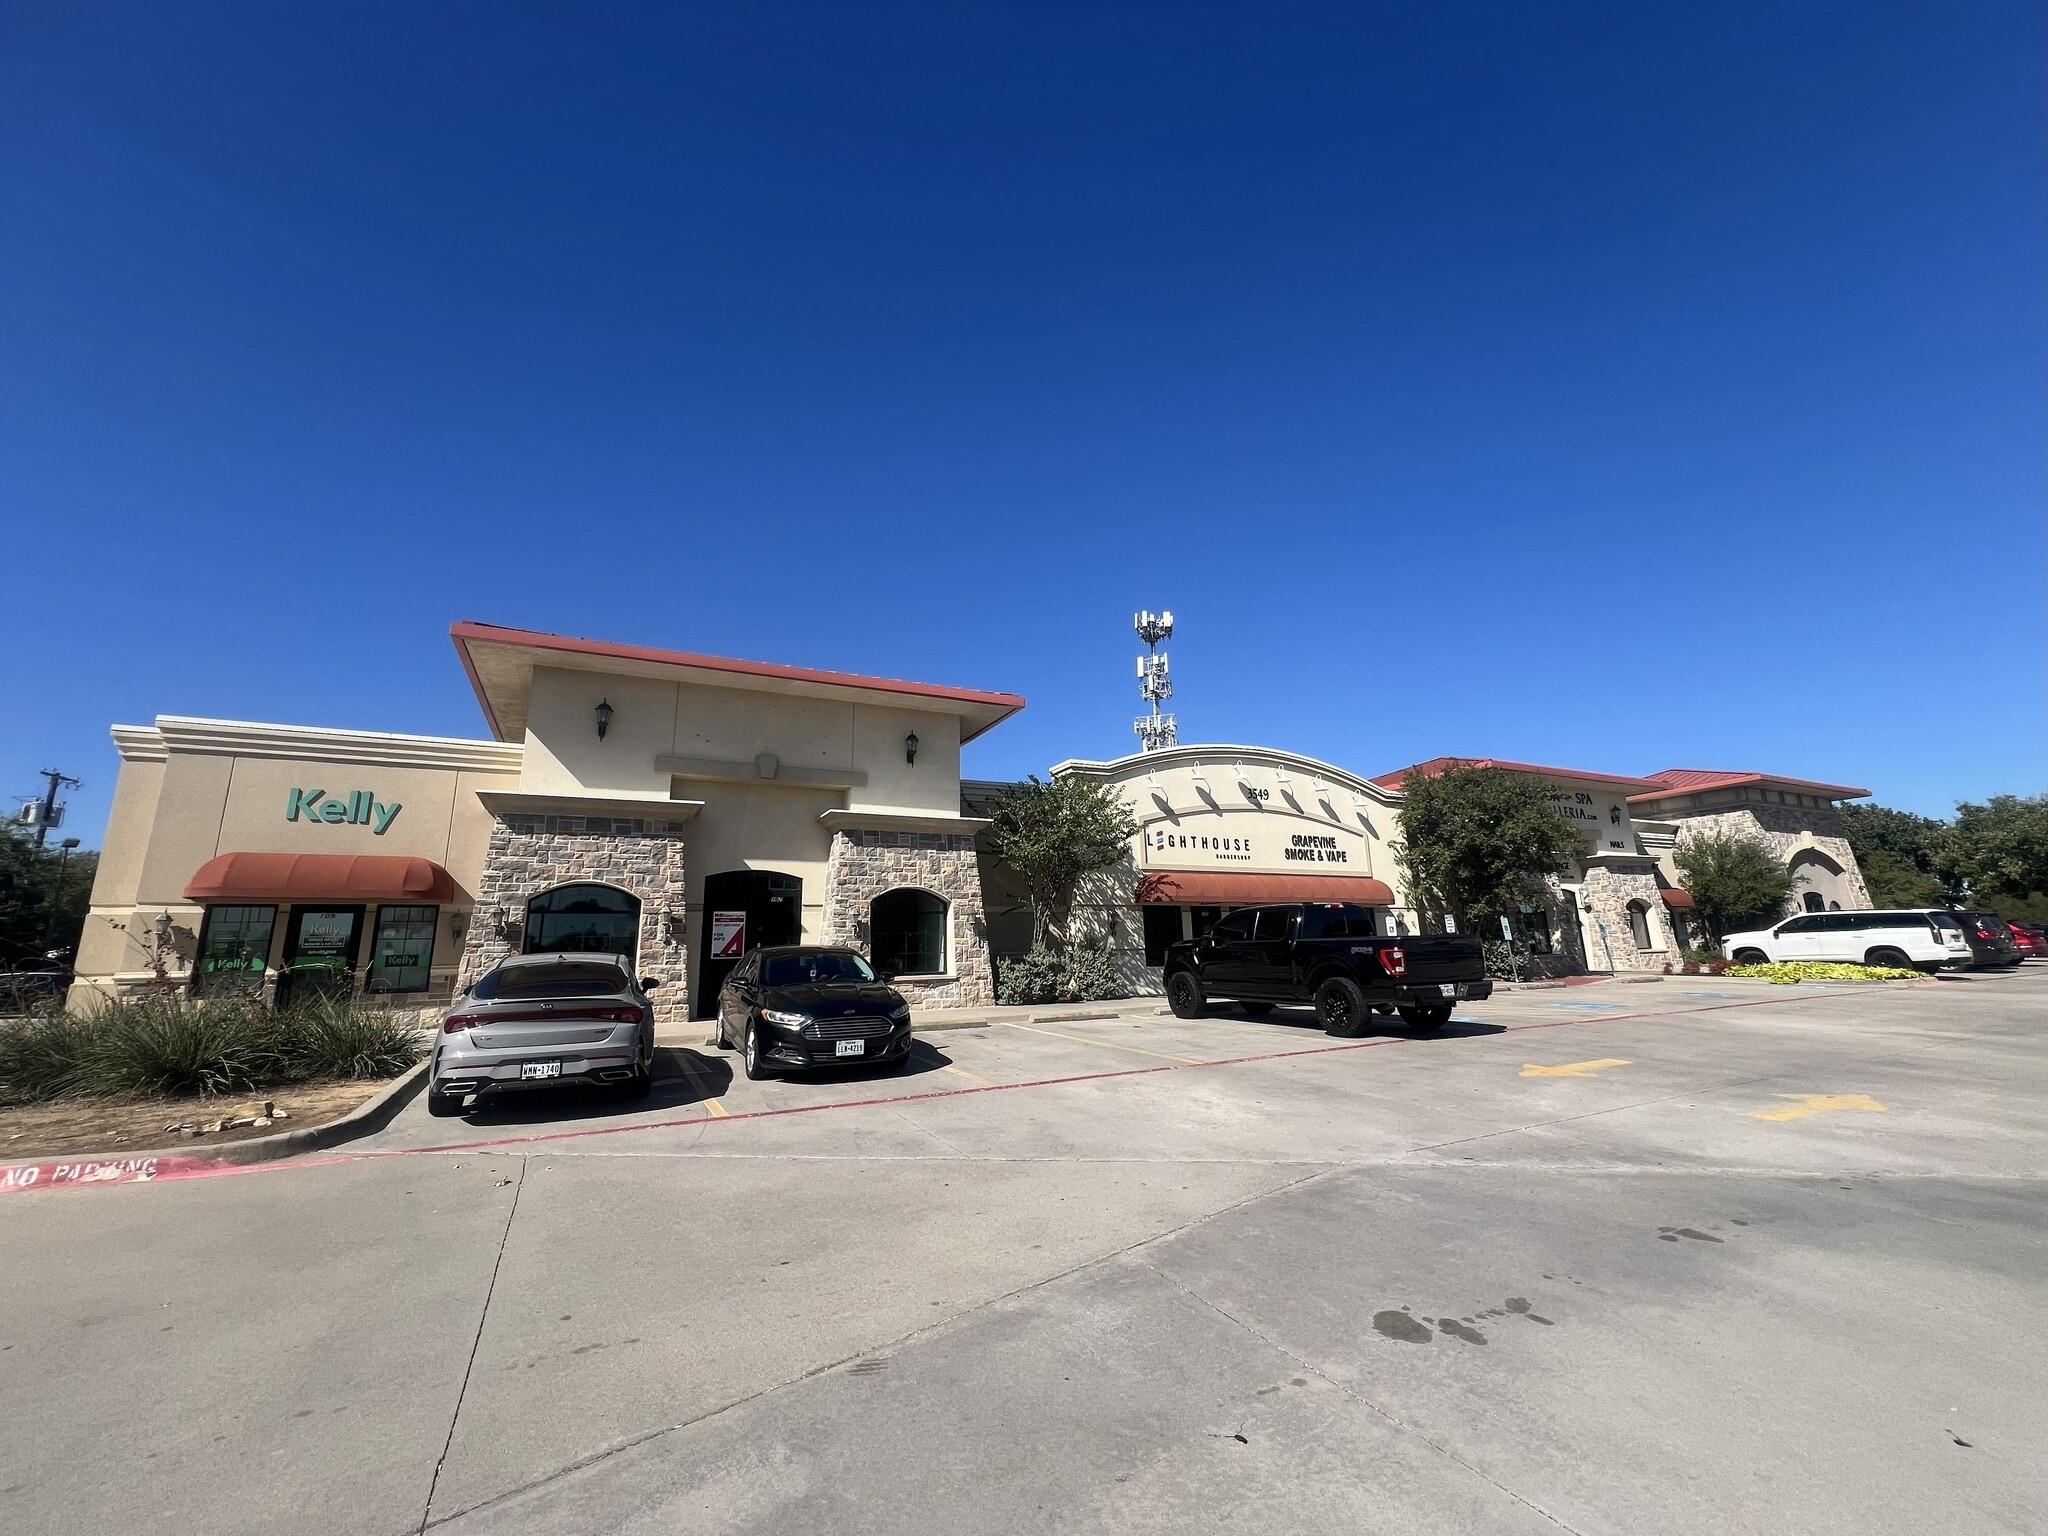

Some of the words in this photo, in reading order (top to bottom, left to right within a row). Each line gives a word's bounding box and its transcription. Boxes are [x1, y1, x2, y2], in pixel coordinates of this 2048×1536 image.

[1248, 788, 1269, 800] 3549
[1575, 792, 1593, 806] SPA
[286, 787, 402, 836] Kelly
[1291, 834, 1337, 849] GRAPEVINE
[1609, 841, 1625, 849] NAILS
[1284, 848, 1315, 862] SMOKE
[1317, 849, 1324, 862] &
[1325, 850, 1347, 863] VAPE
[310, 924, 340, 936] Kelly
[217, 959, 249, 972] Kelly
[388, 955, 415, 966] Kelly
[523, 1065, 559, 1075] WMN-1740
[0, 1166, 40, 1188] NO
[52, 1158, 157, 1181] PARNG
